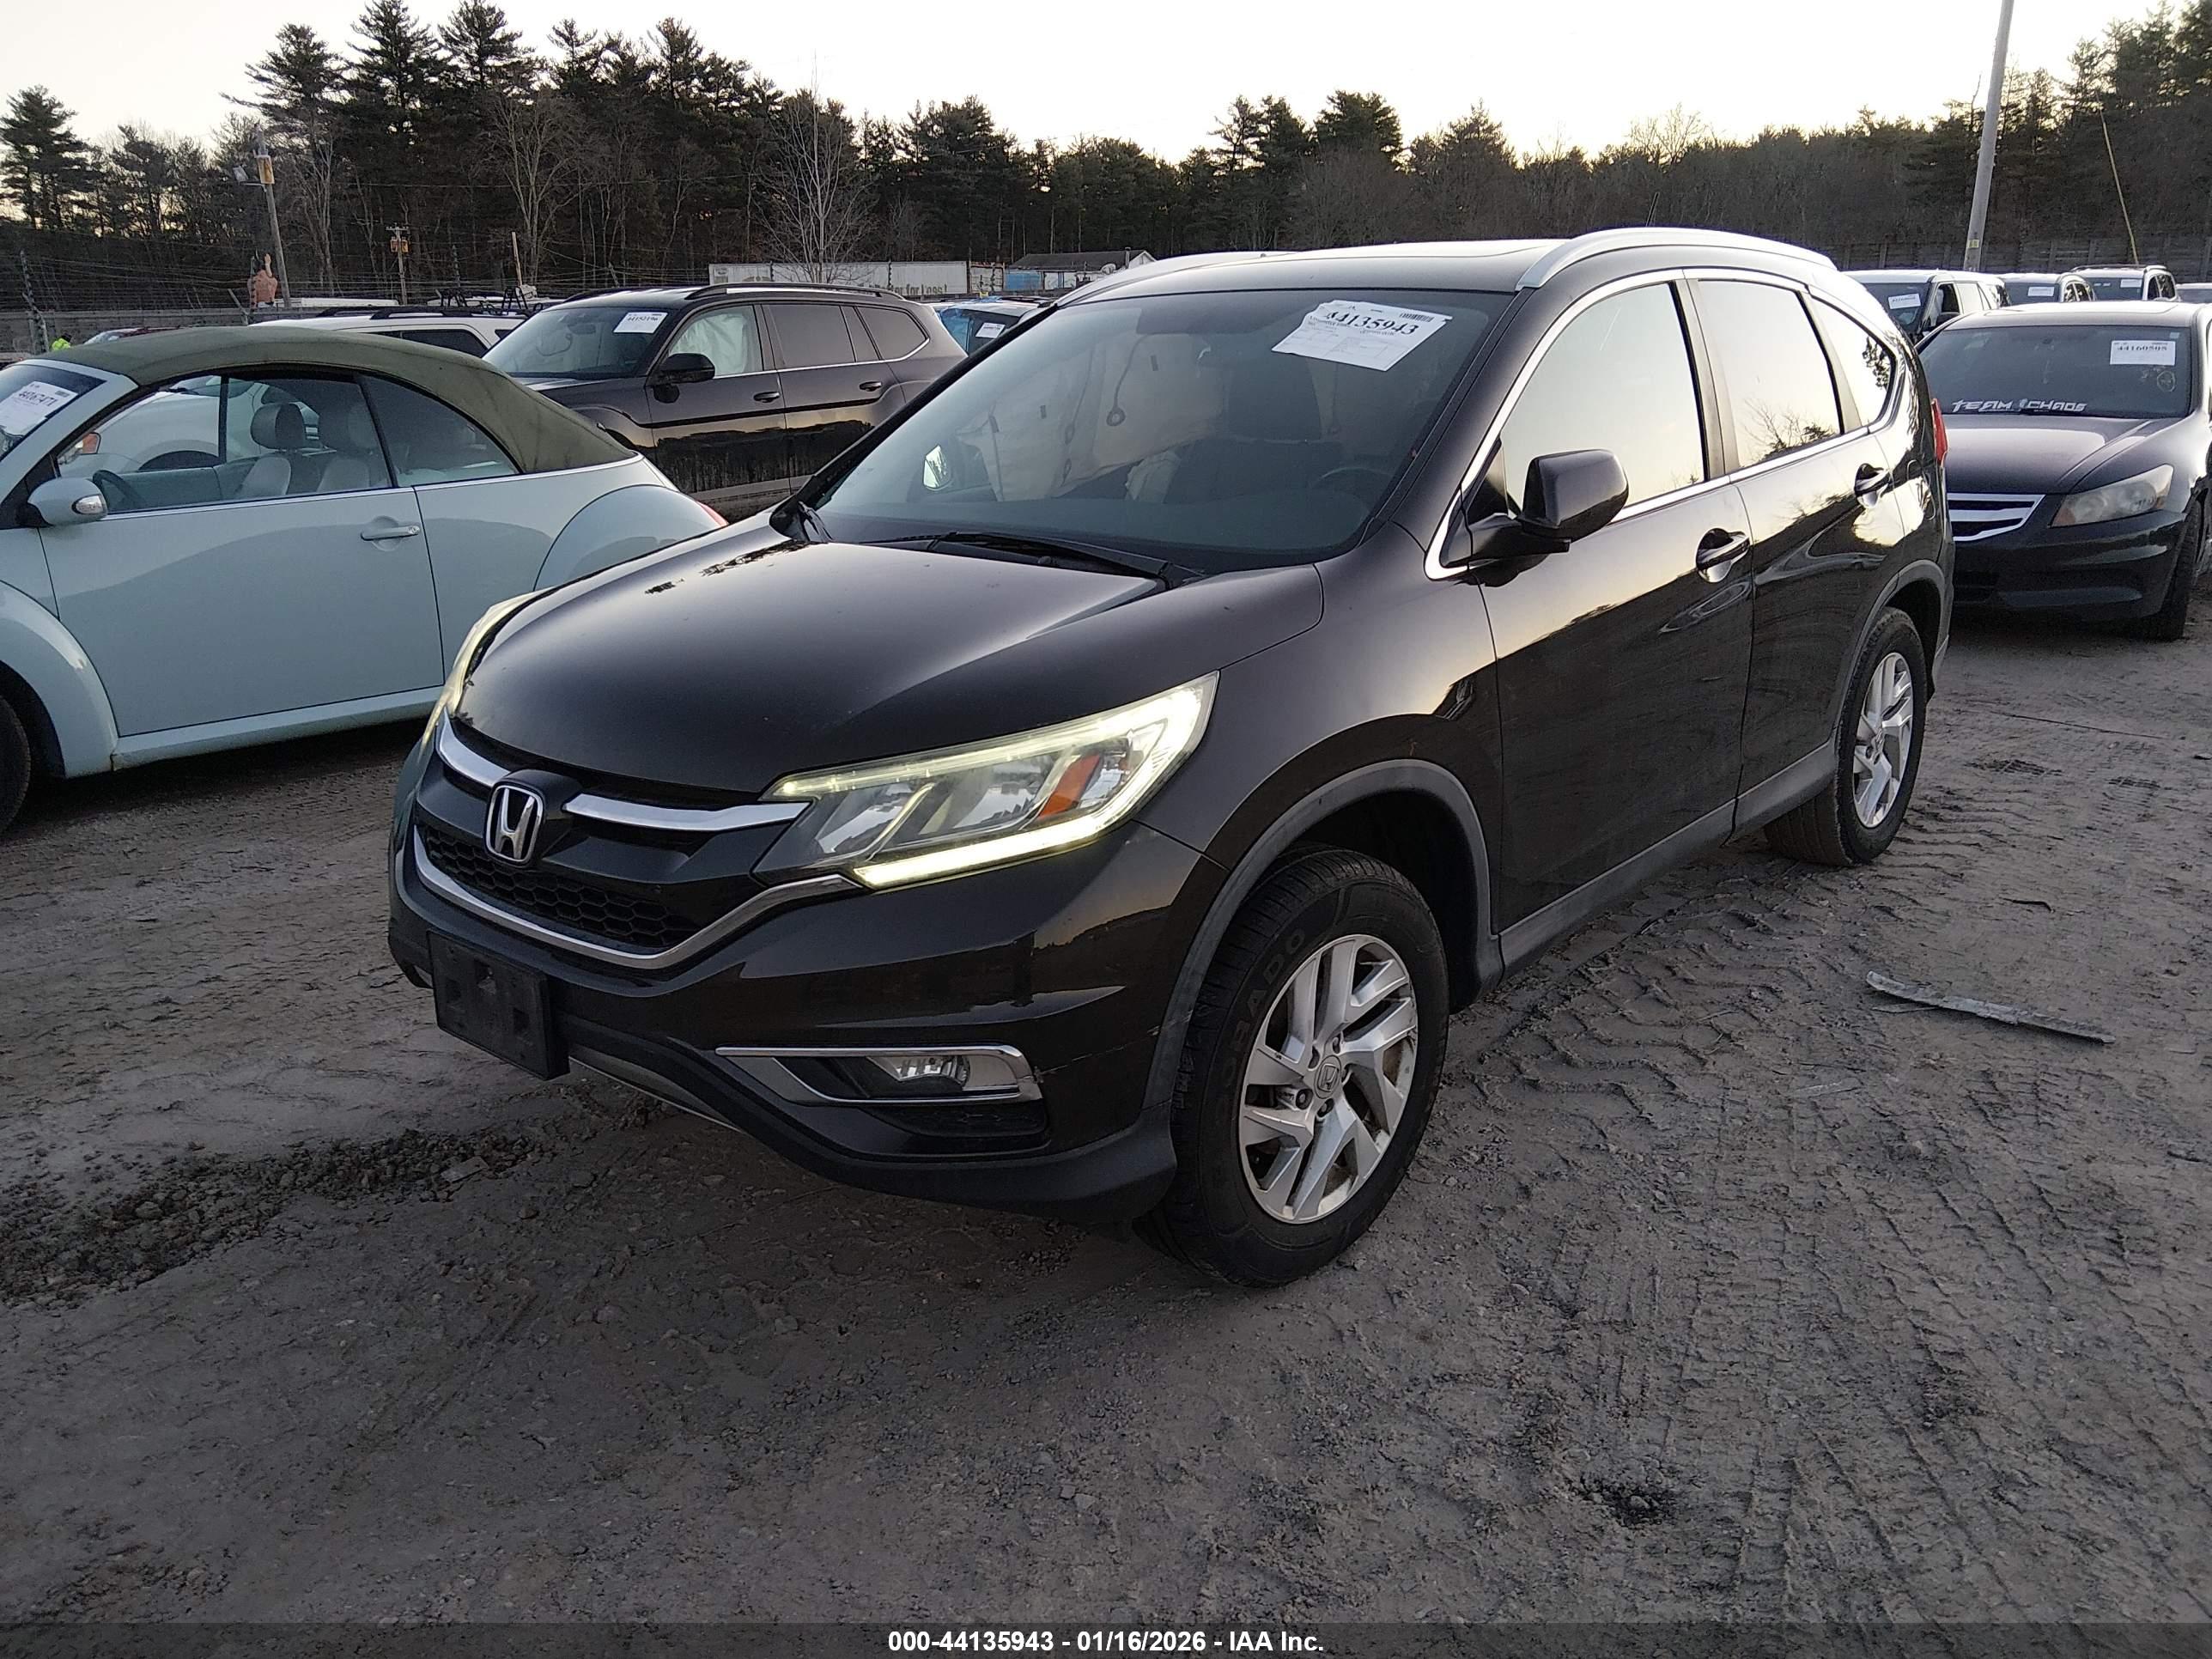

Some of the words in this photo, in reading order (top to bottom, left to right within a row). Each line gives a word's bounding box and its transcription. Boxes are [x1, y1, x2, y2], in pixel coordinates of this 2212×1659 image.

[1323, 310, 1419, 335] 44135943
[1952, 399, 2014, 413] TEAM
[2027, 399, 2087, 412] CHAOS
